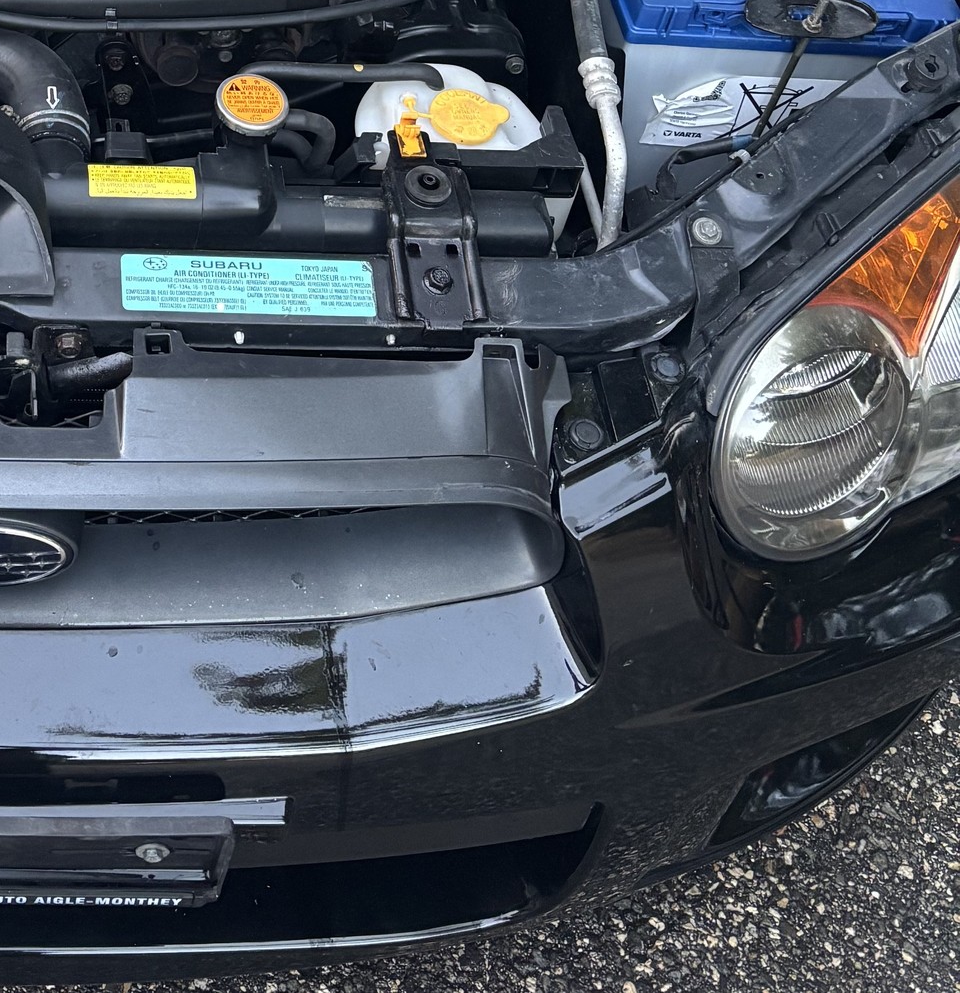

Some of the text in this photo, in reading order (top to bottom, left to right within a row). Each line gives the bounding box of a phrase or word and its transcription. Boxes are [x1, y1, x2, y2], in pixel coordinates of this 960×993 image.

[190, 260, 262, 270] SUBARU
[187, 269, 236, 278] CONDITIONER
[34, 896, 182, 906] AIGLE-MONTHEY
